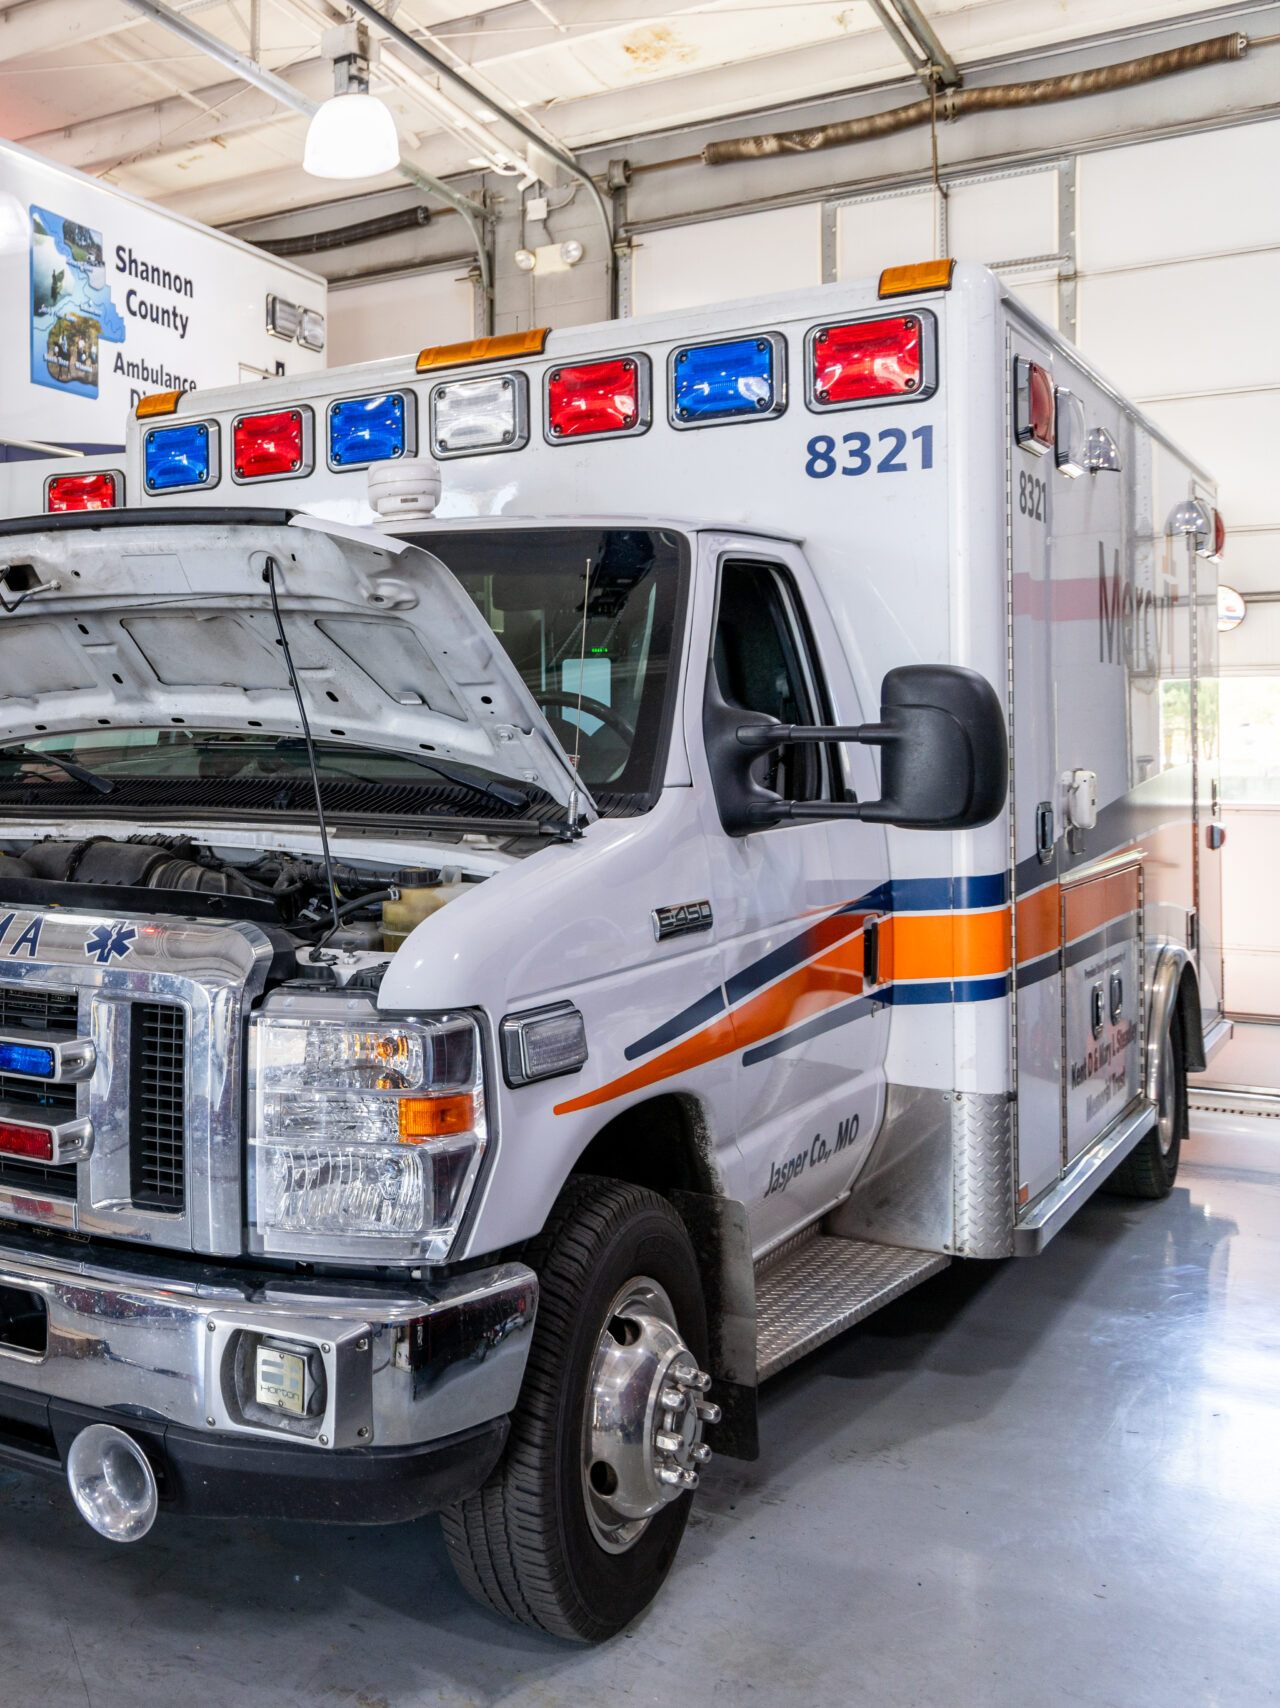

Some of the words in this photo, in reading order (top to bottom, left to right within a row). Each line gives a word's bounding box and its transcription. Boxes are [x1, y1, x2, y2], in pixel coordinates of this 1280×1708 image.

[115, 245, 194, 298] Shannon
[126, 289, 189, 339] County
[113, 351, 197, 392] Ambulance
[805, 424, 934, 479] 8321
[1019, 469, 1047, 524] 8321
[1098, 540, 1167, 680] Mercy
[763, 1148, 809, 1199] Jasper
[833, 1112, 860, 1154] MO
[260, 1384, 300, 1401] Horton
